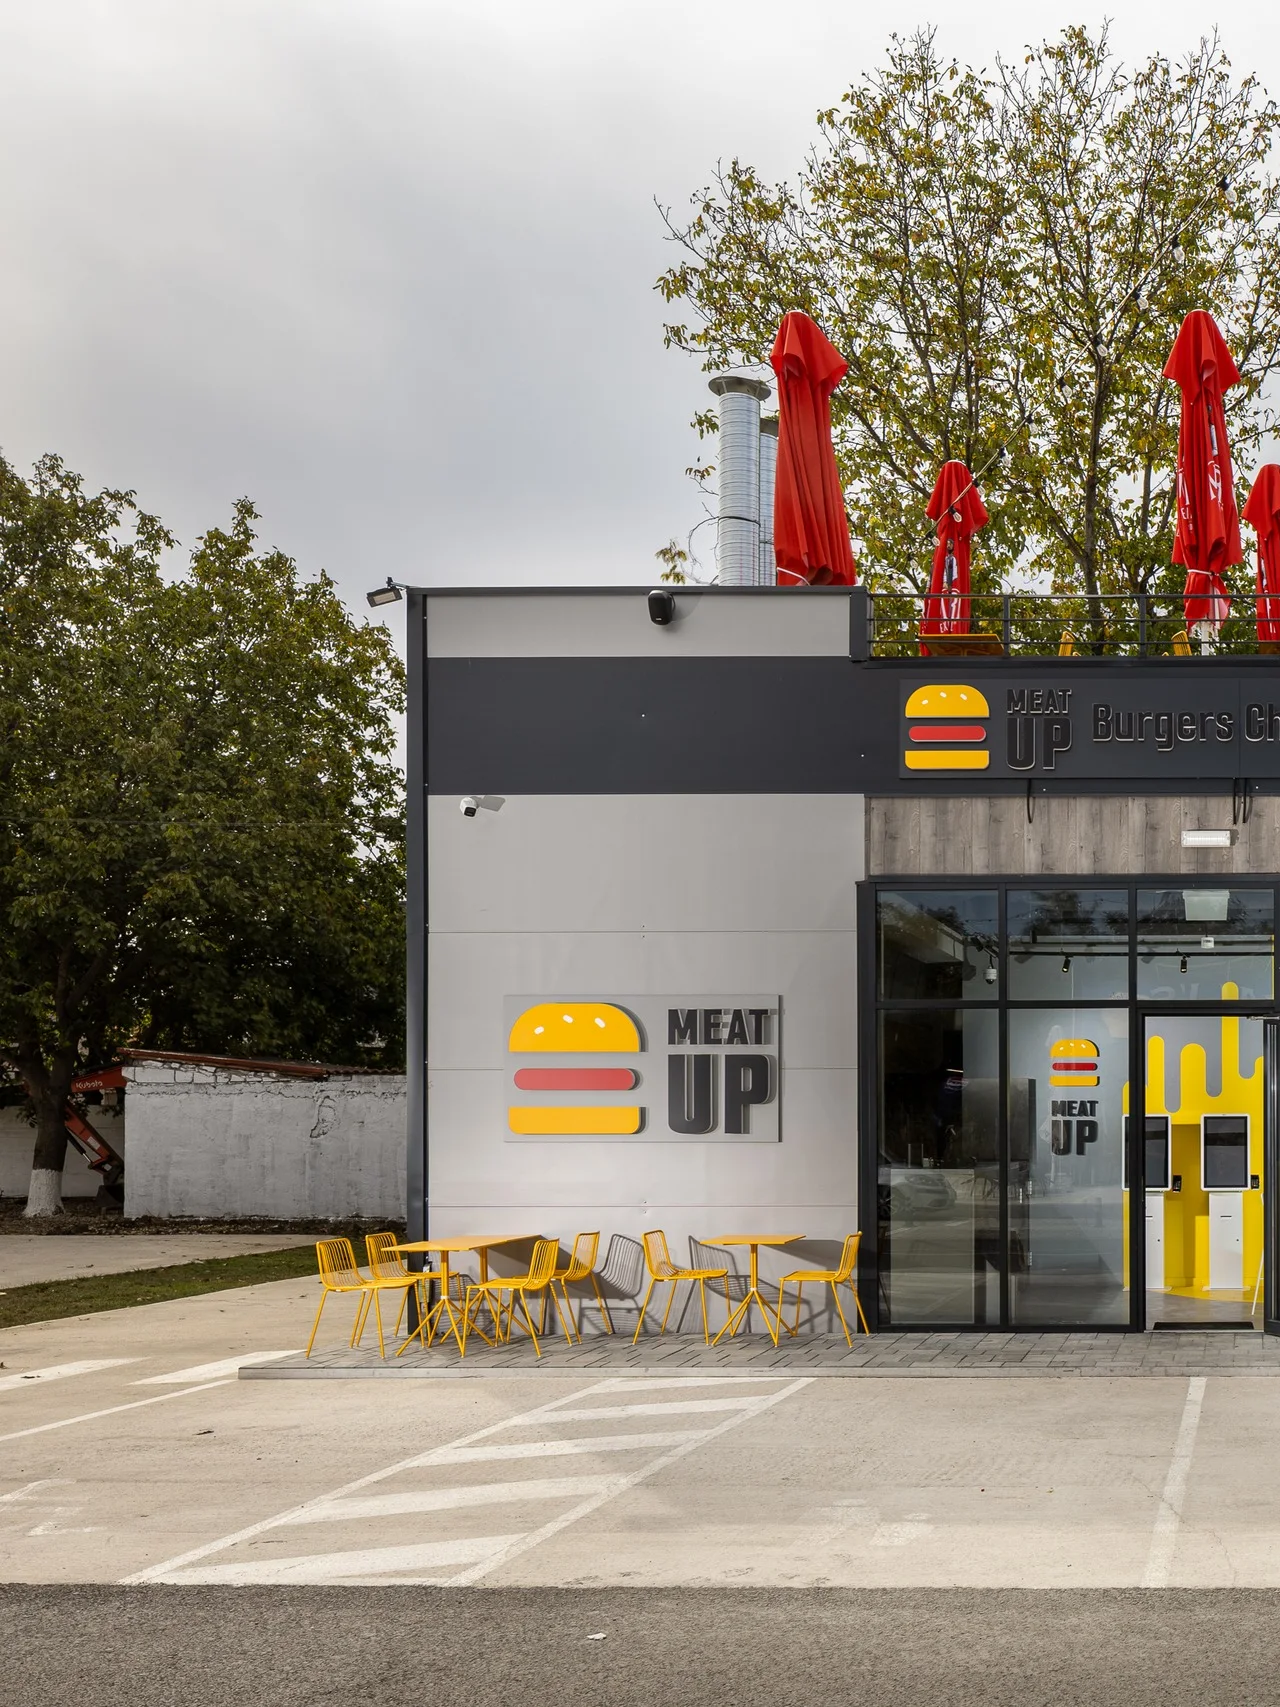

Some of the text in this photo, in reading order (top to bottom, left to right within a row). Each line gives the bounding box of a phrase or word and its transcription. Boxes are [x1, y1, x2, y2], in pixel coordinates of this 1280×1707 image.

[1006, 688, 1072, 714] MEAT
[1006, 717, 1072, 770] UP
[1092, 703, 1234, 752] Burgers
[667, 1008, 770, 1046] MEAT
[667, 1053, 773, 1135] UP
[1051, 1099, 1099, 1118] MEAT
[1051, 1119, 1099, 1157] UP
